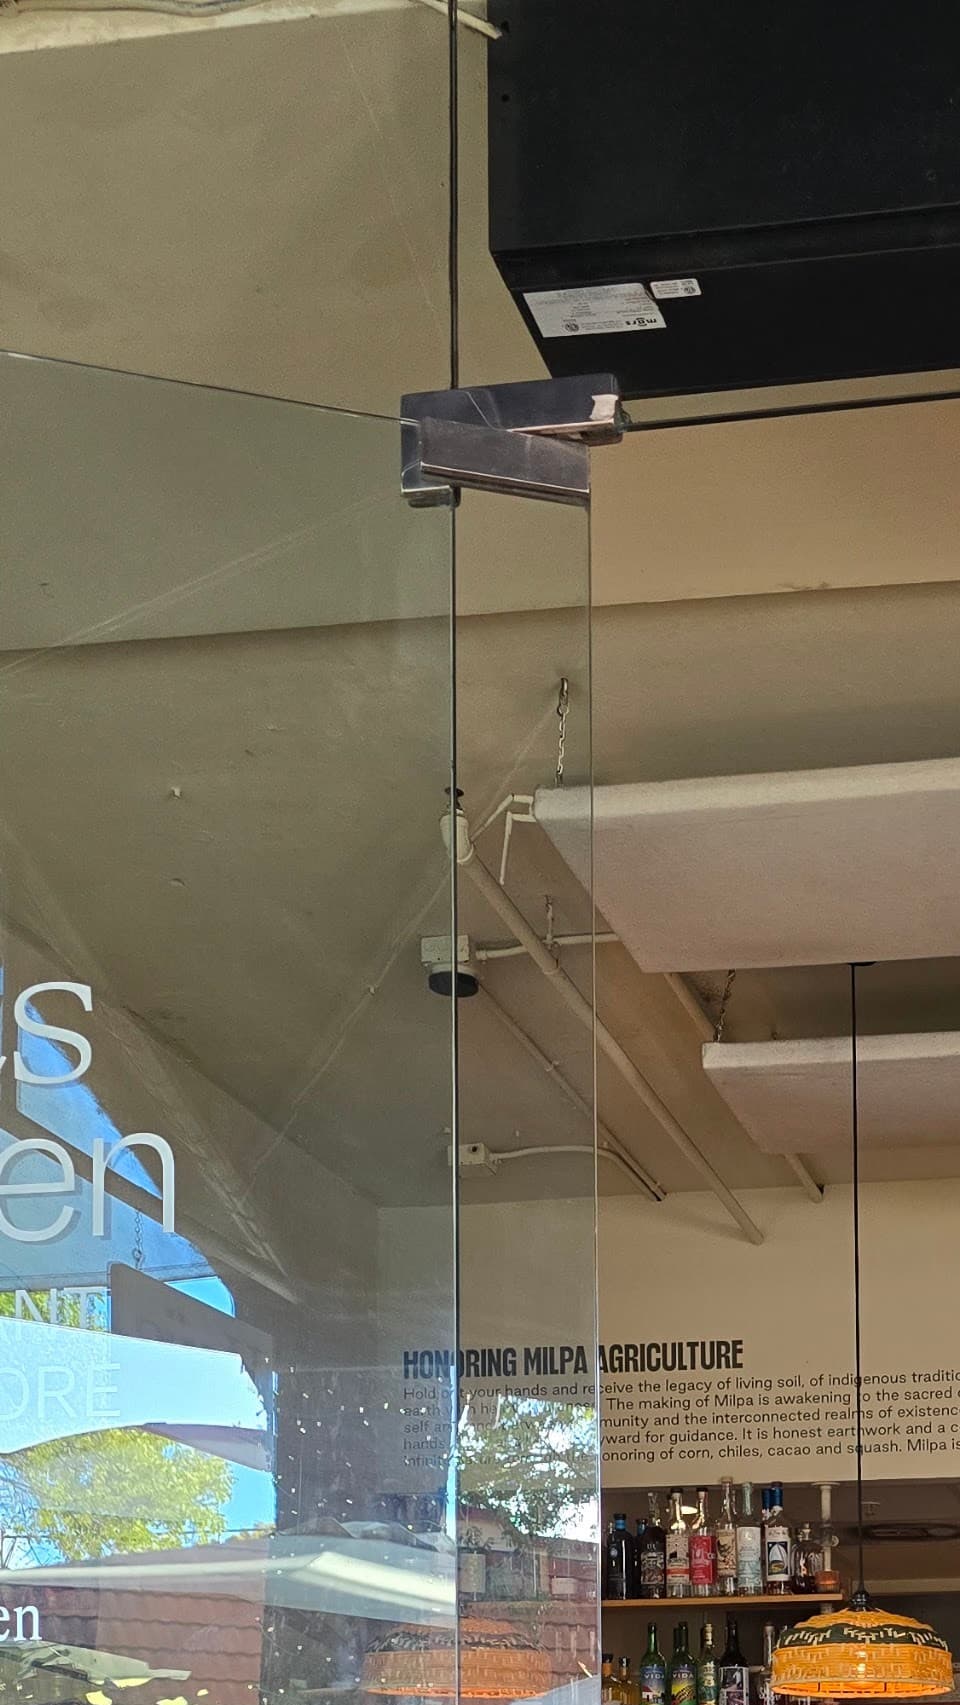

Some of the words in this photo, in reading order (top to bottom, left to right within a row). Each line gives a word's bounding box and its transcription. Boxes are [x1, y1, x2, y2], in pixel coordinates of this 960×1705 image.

[0, 981, 93, 1084] s
[404, 1348, 516, 1379] HONORING
[524, 1346, 588, 1375] MILPA
[597, 1340, 743, 1373] AGRICULTURE
[404, 1387, 436, 1399] Hold
[441, 1388, 465, 1399] ot
[467, 1388, 500, 1401] your
[505, 1384, 547, 1397] hands
[552, 1382, 578, 1395] and
[583, 1380, 633, 1395] receive
[639, 1380, 661, 1392] the
[666, 1378, 712, 1394] legacy
[717, 1377, 732, 1390] of
[736, 1376, 772, 1391] living
[777, 1375, 805, 1388] soil,
[810, 1374, 825, 1387] of
[829, 1372, 906, 1388] indigenous
[606, 1398, 634, 1410] The
[639, 1396, 691, 1411] making
[695, 1395, 710, 1408] of
[714, 1394, 754, 1408] Milpa
[758, 1394, 770, 1406] is
[774, 1391, 851, 1406] awakening
[876, 1389, 899, 1401] the
[904, 1386, 952, 1400] sacred
[601, 1414, 649, 1430] munity
[654, 1413, 680, 1426] and
[685, 1412, 708, 1425] the
[712, 1408, 820, 1424] interconnected
[825, 1407, 873, 1421] realms
[878, 1406, 893, 1418] of
[645, 1430, 665, 1444] for
[669, 1429, 738, 1445] guidance.
[742, 1428, 752, 1440] It
[757, 1428, 769, 1440] is
[773, 1426, 822, 1440] honest
[827, 1423, 900, 1438] earthwork
[906, 1421, 932, 1435] and
[937, 1424, 946, 1434] a
[602, 1449, 655, 1463] onoring
[659, 1448, 675, 1461] of
[678, 1447, 714, 1461] corn,
[718, 1445, 763, 1459] chiles,
[767, 1446, 811, 1457] cacao
[816, 1442, 842, 1456] and
[847, 1440, 902, 1456] squash.
[907, 1438, 948, 1453] Milpa
[0, 1605, 42, 1641] en
